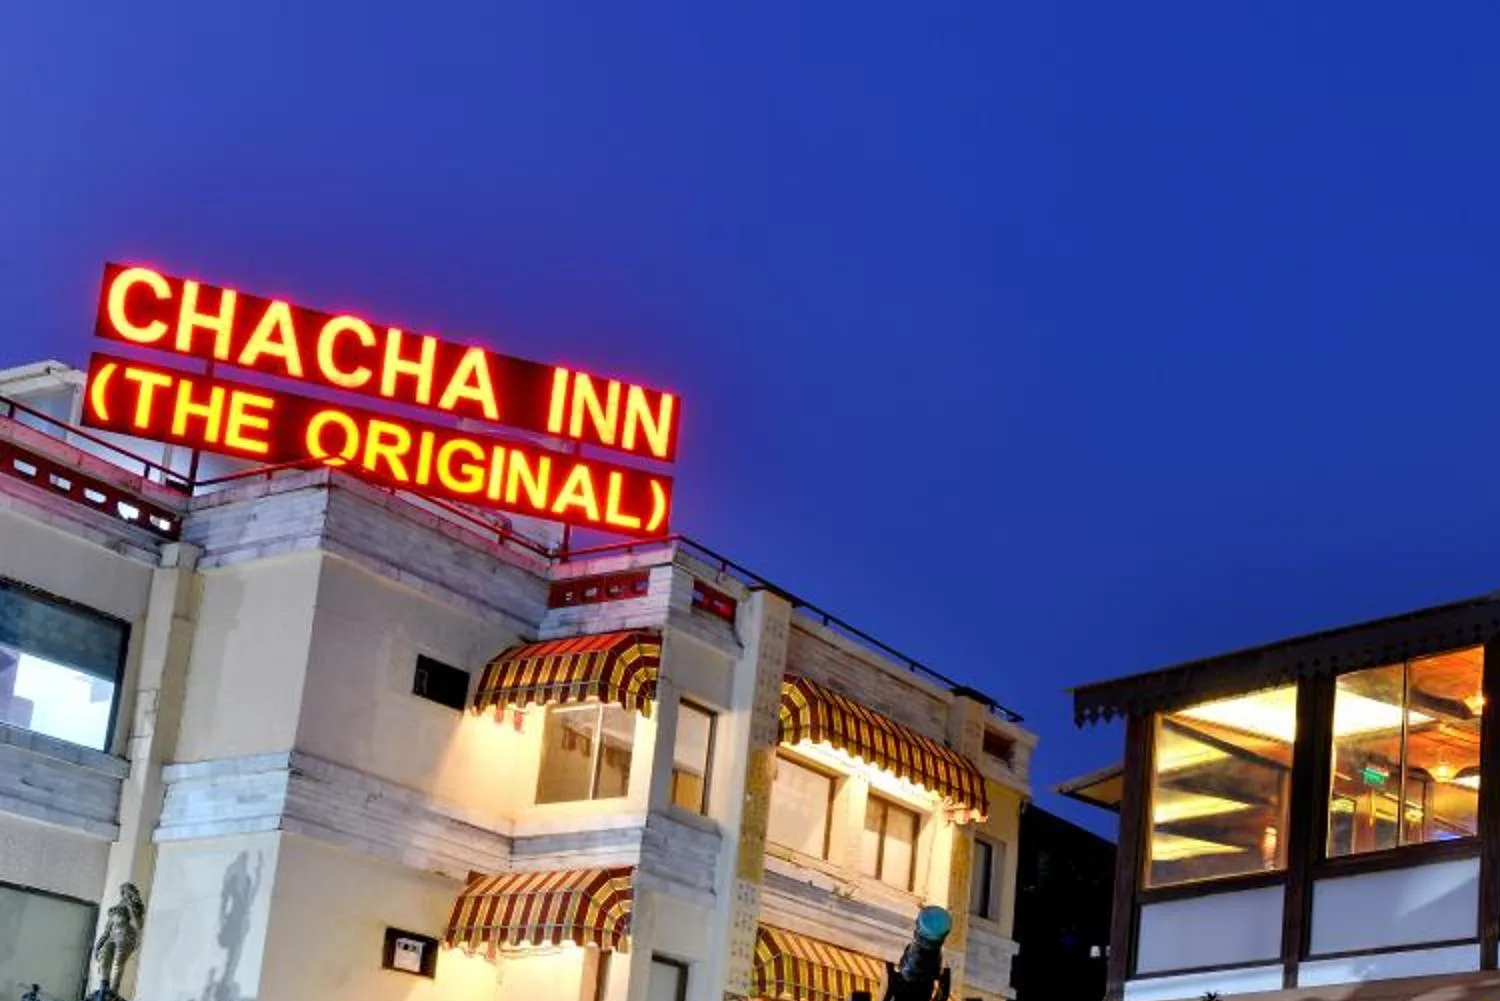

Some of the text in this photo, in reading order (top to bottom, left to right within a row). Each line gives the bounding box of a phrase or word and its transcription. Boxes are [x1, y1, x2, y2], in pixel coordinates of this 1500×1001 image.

[90, 362, 667, 532] (THE ORIGINAL)
[106, 266, 674, 458] CHACHA INN
